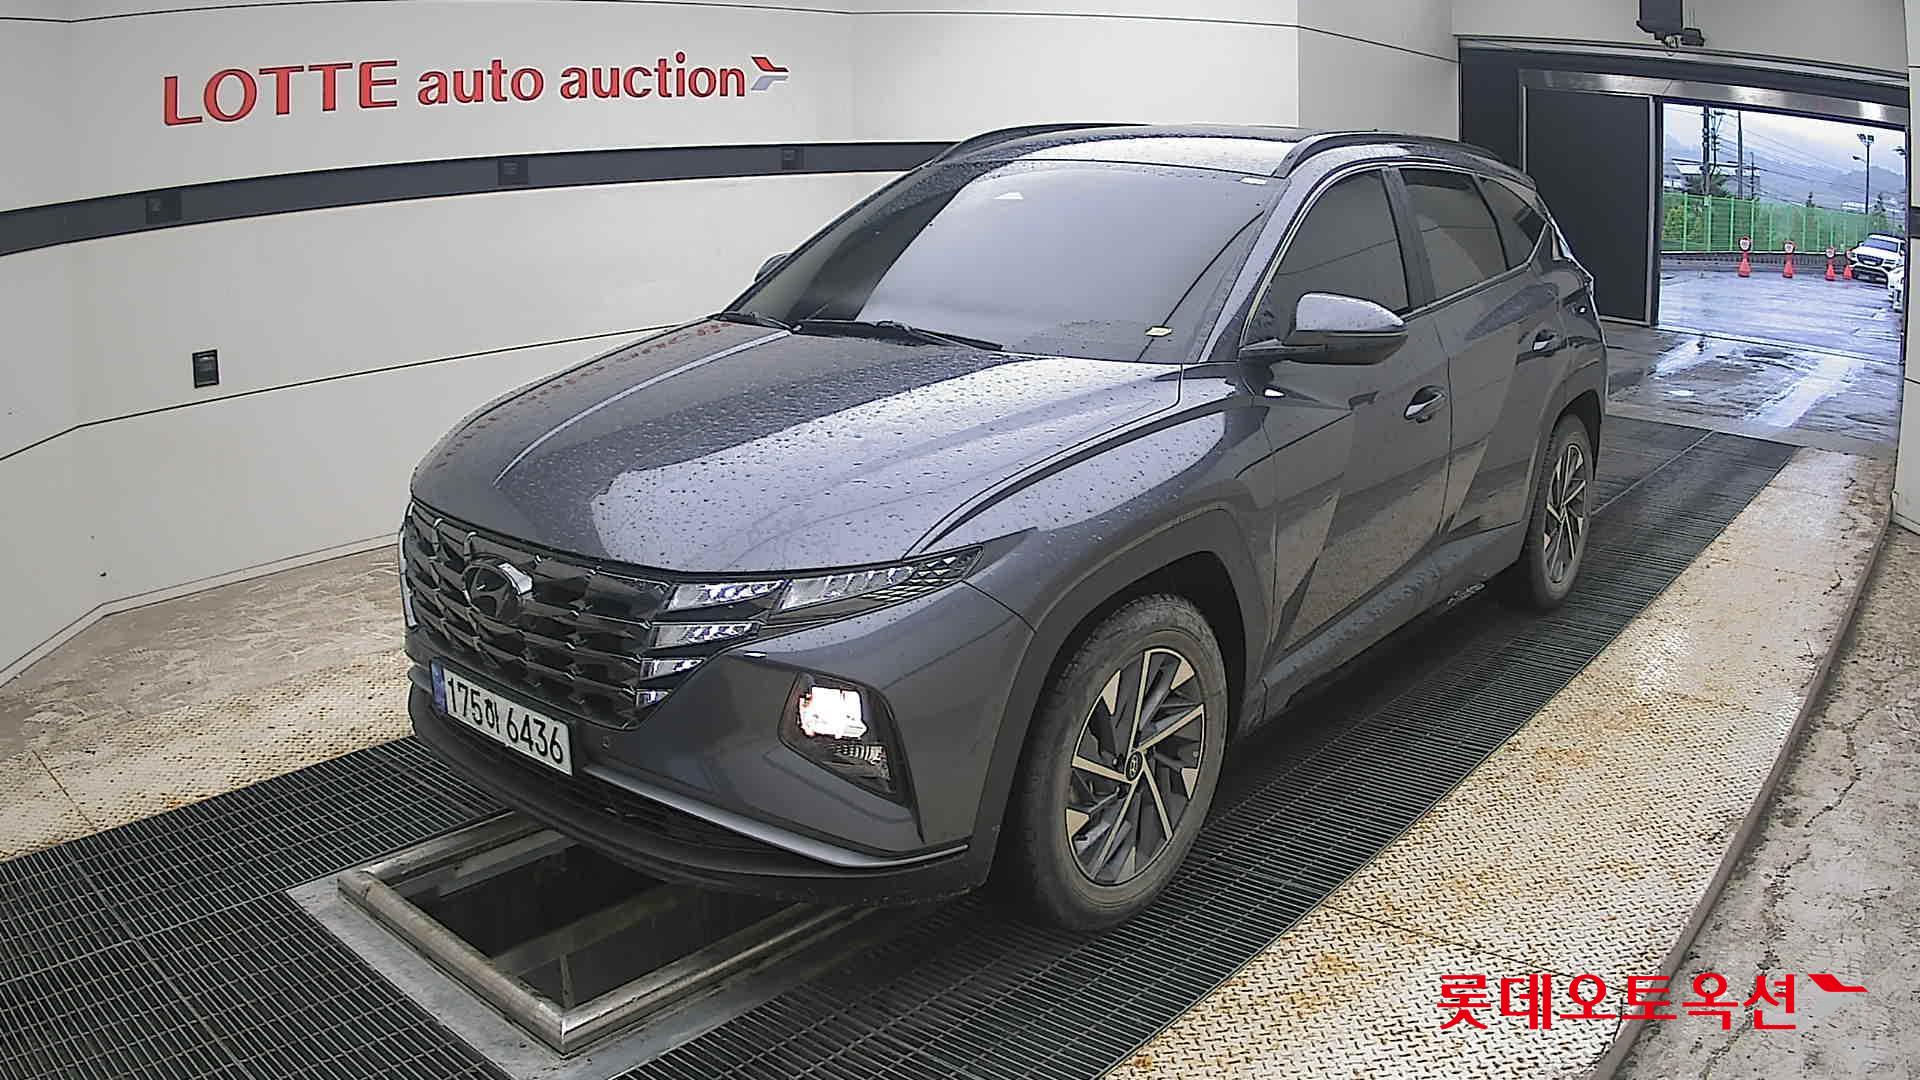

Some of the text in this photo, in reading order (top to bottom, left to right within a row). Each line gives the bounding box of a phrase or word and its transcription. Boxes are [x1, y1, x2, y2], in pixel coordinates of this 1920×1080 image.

[163, 51, 746, 126] LOTTE auto auction
[506, 707, 564, 765] 6436
